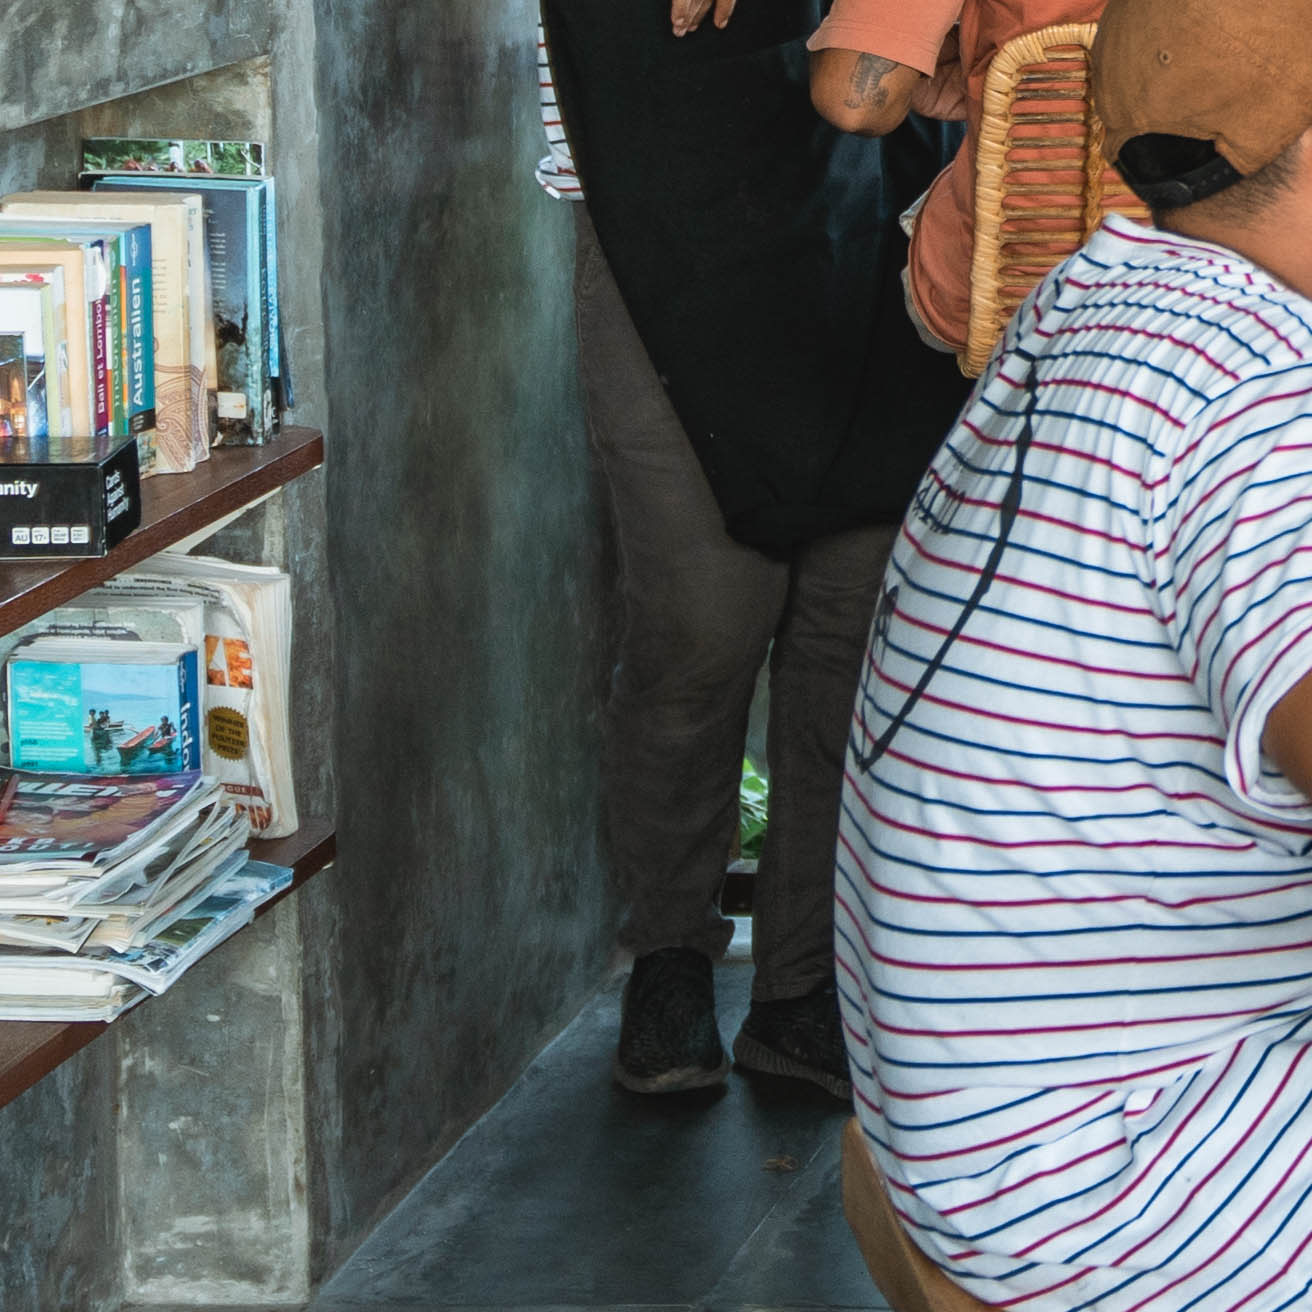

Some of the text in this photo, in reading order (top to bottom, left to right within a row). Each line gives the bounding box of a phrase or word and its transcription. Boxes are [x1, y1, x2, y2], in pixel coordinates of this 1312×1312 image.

[131, 277, 144, 406] Australien
[96, 363, 105, 378] et
[96, 383, 105, 414] Bali
[180, 702, 193, 772] Indo
